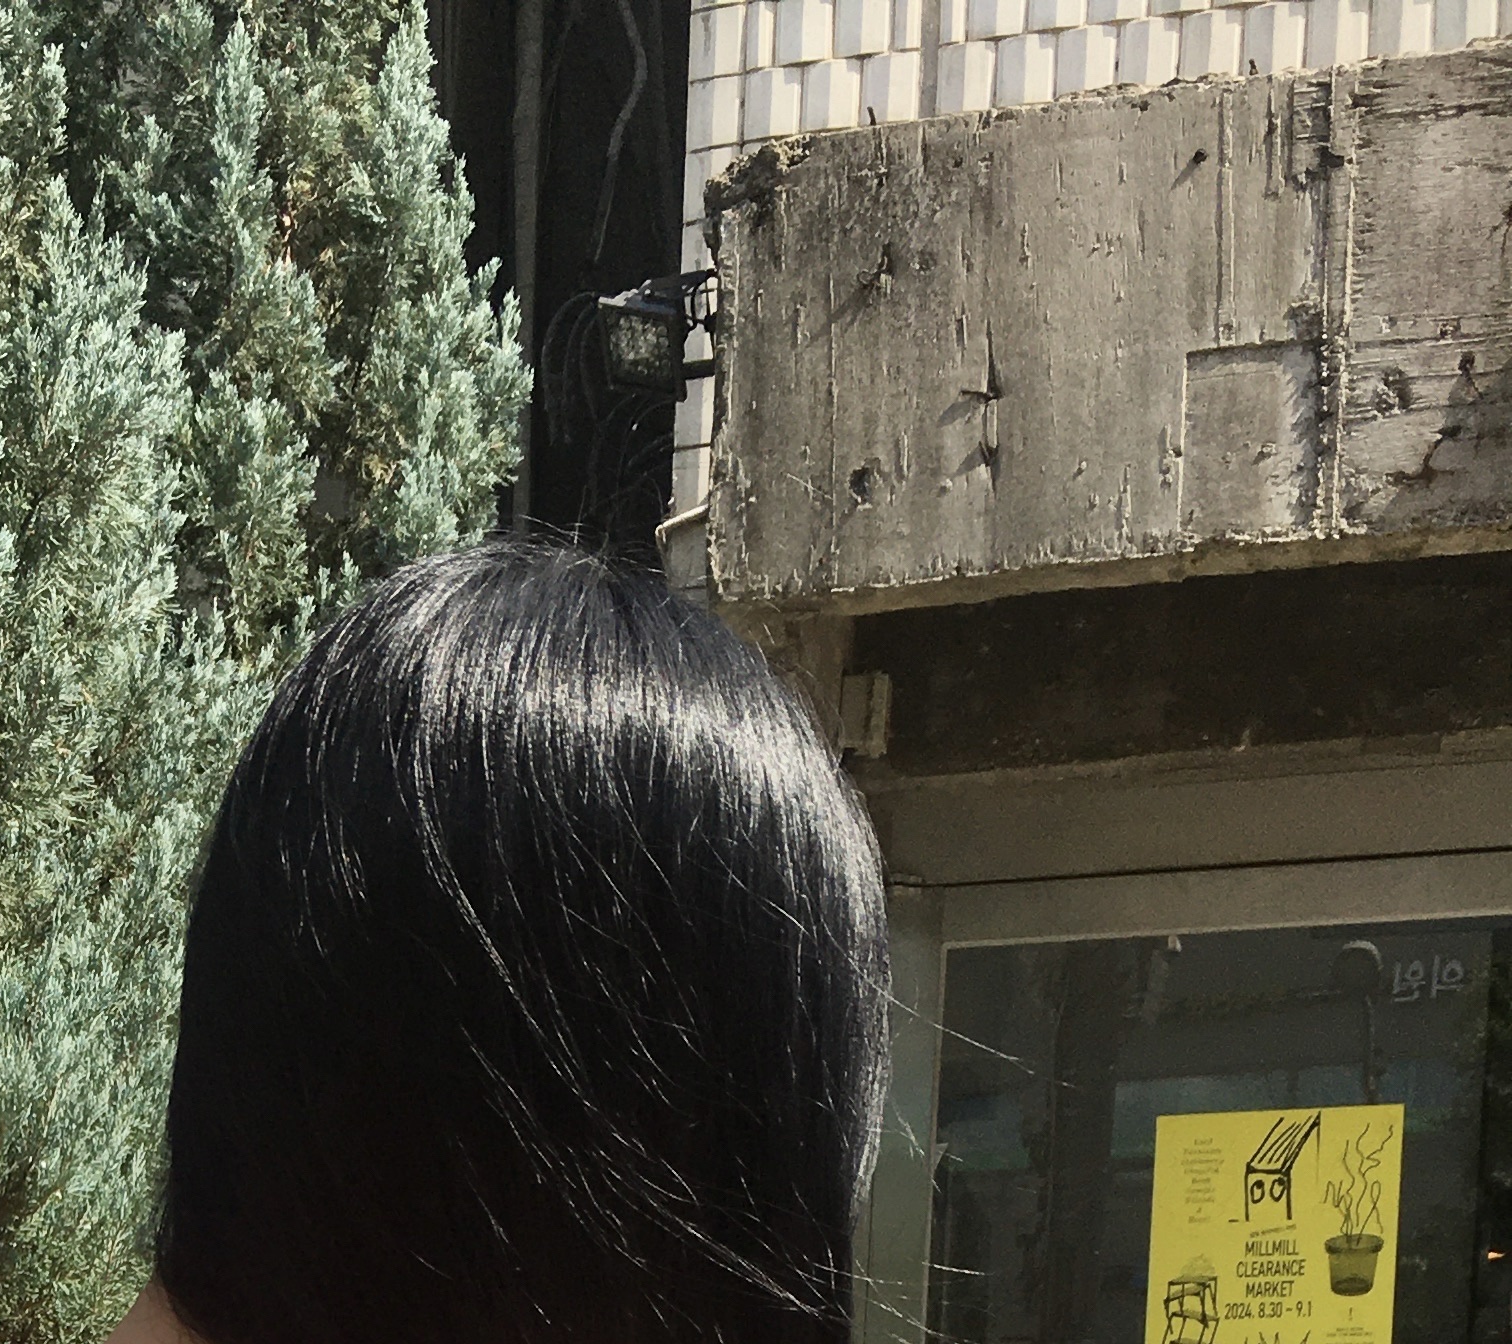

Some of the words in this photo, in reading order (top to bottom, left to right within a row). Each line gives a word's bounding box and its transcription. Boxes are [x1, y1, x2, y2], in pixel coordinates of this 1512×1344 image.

[1245, 1239, 1299, 1257] MILLMILL
[1236, 1259, 1306, 1278] CLEARANCE
[1245, 1280, 1295, 1298] MARKET
[1224, 1302, 1255, 1319] 2024.
[1258, 1302, 1283, 1318] 8.30
[1296, 1300, 1312, 1317] 9.1
